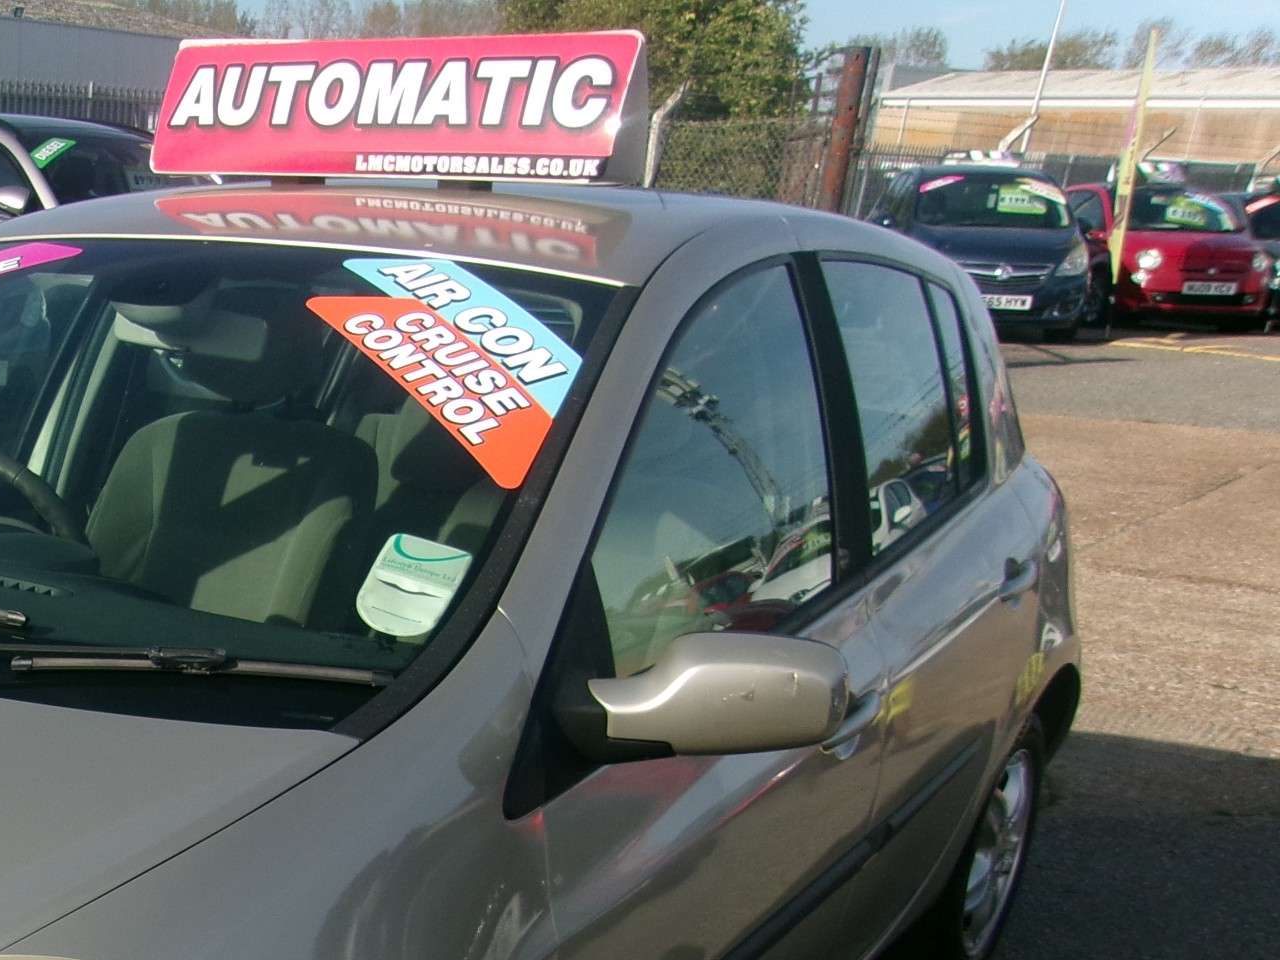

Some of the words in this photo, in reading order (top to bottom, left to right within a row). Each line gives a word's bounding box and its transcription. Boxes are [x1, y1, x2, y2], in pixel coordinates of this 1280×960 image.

[168, 54, 615, 130] AUTOMATIC
[354, 154, 600, 178] LMCMOTORSALES.CO.UK
[378, 262, 472, 309] AIR
[453, 306, 570, 386] CON
[393, 312, 531, 418] CRUISE
[343, 312, 500, 447] CONTROL
